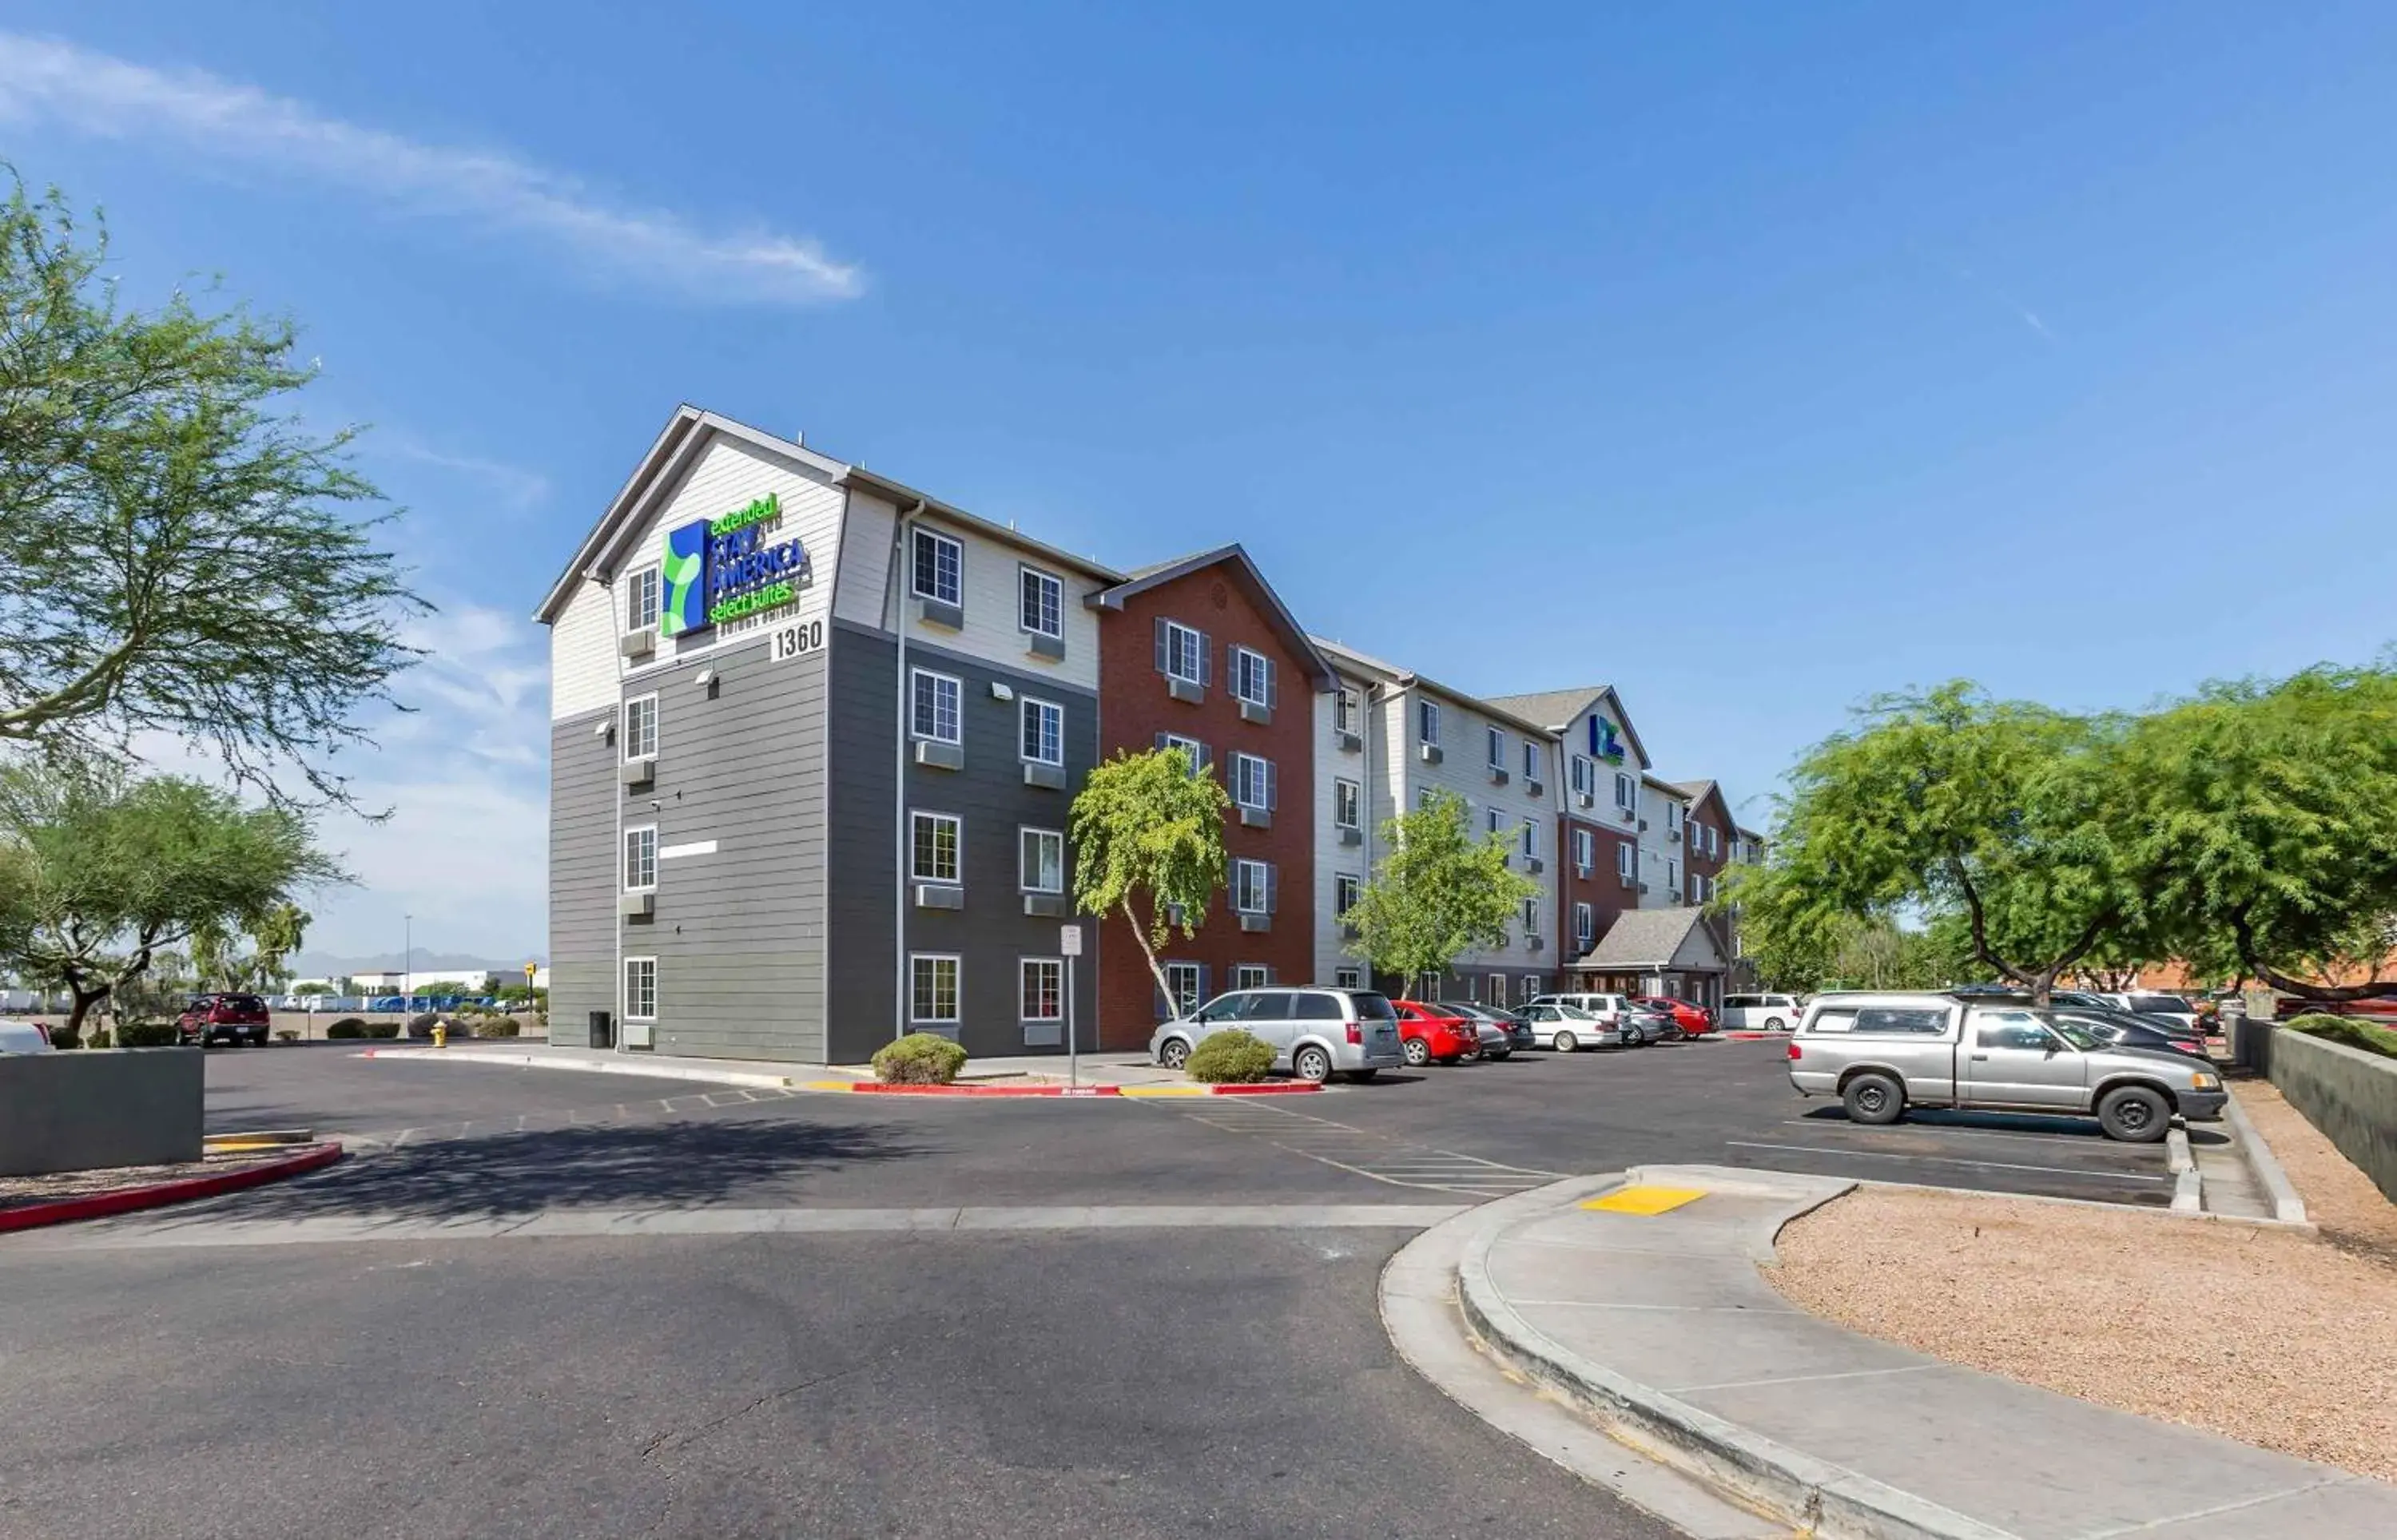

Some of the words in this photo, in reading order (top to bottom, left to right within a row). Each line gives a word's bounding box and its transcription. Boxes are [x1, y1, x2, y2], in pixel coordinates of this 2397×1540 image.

[710, 492, 777, 536] extended
[712, 538, 803, 591] AMERICA
[710, 595, 751, 625] select
[751, 582, 793, 612] suites
[776, 620, 822, 658] 1360
